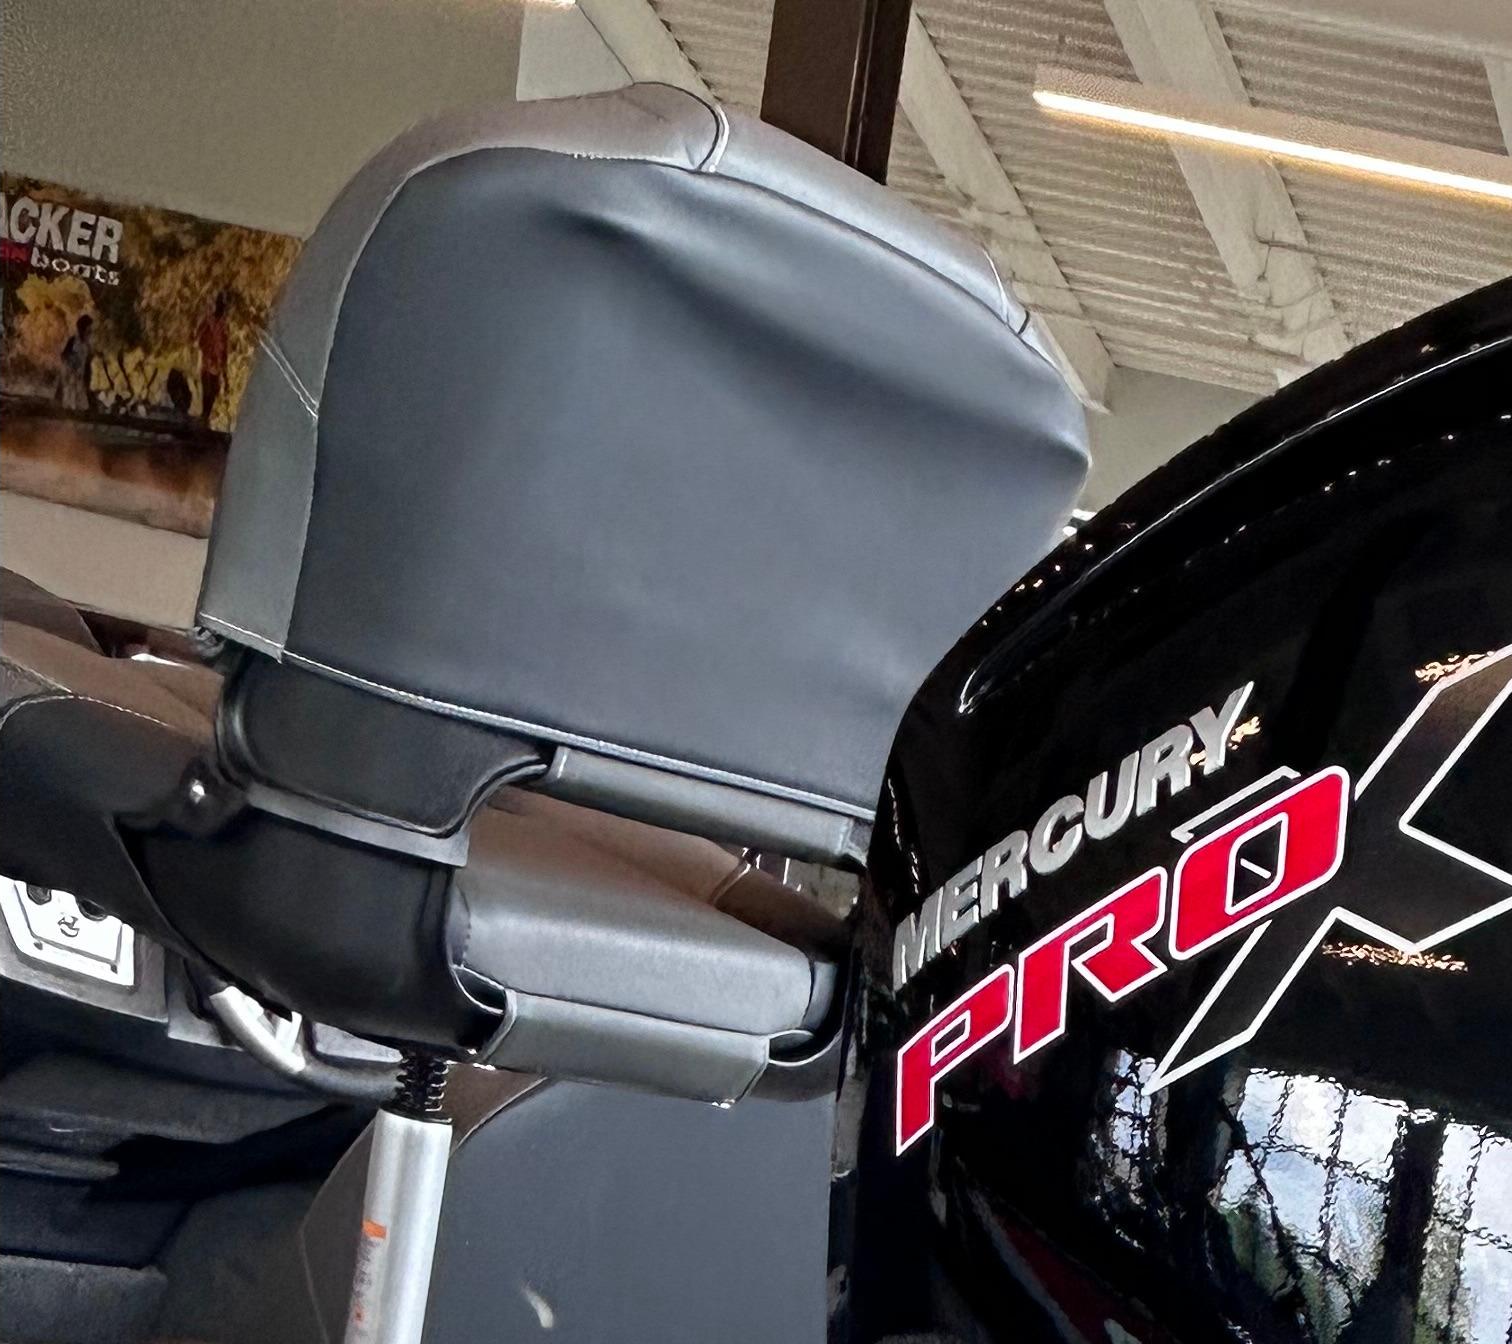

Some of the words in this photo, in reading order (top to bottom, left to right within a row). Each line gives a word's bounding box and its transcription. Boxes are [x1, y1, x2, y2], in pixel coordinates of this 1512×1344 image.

[31, 247, 119, 285] boats
[893, 680, 1255, 991] MERCURY
[895, 764, 1350, 1156] PRO
